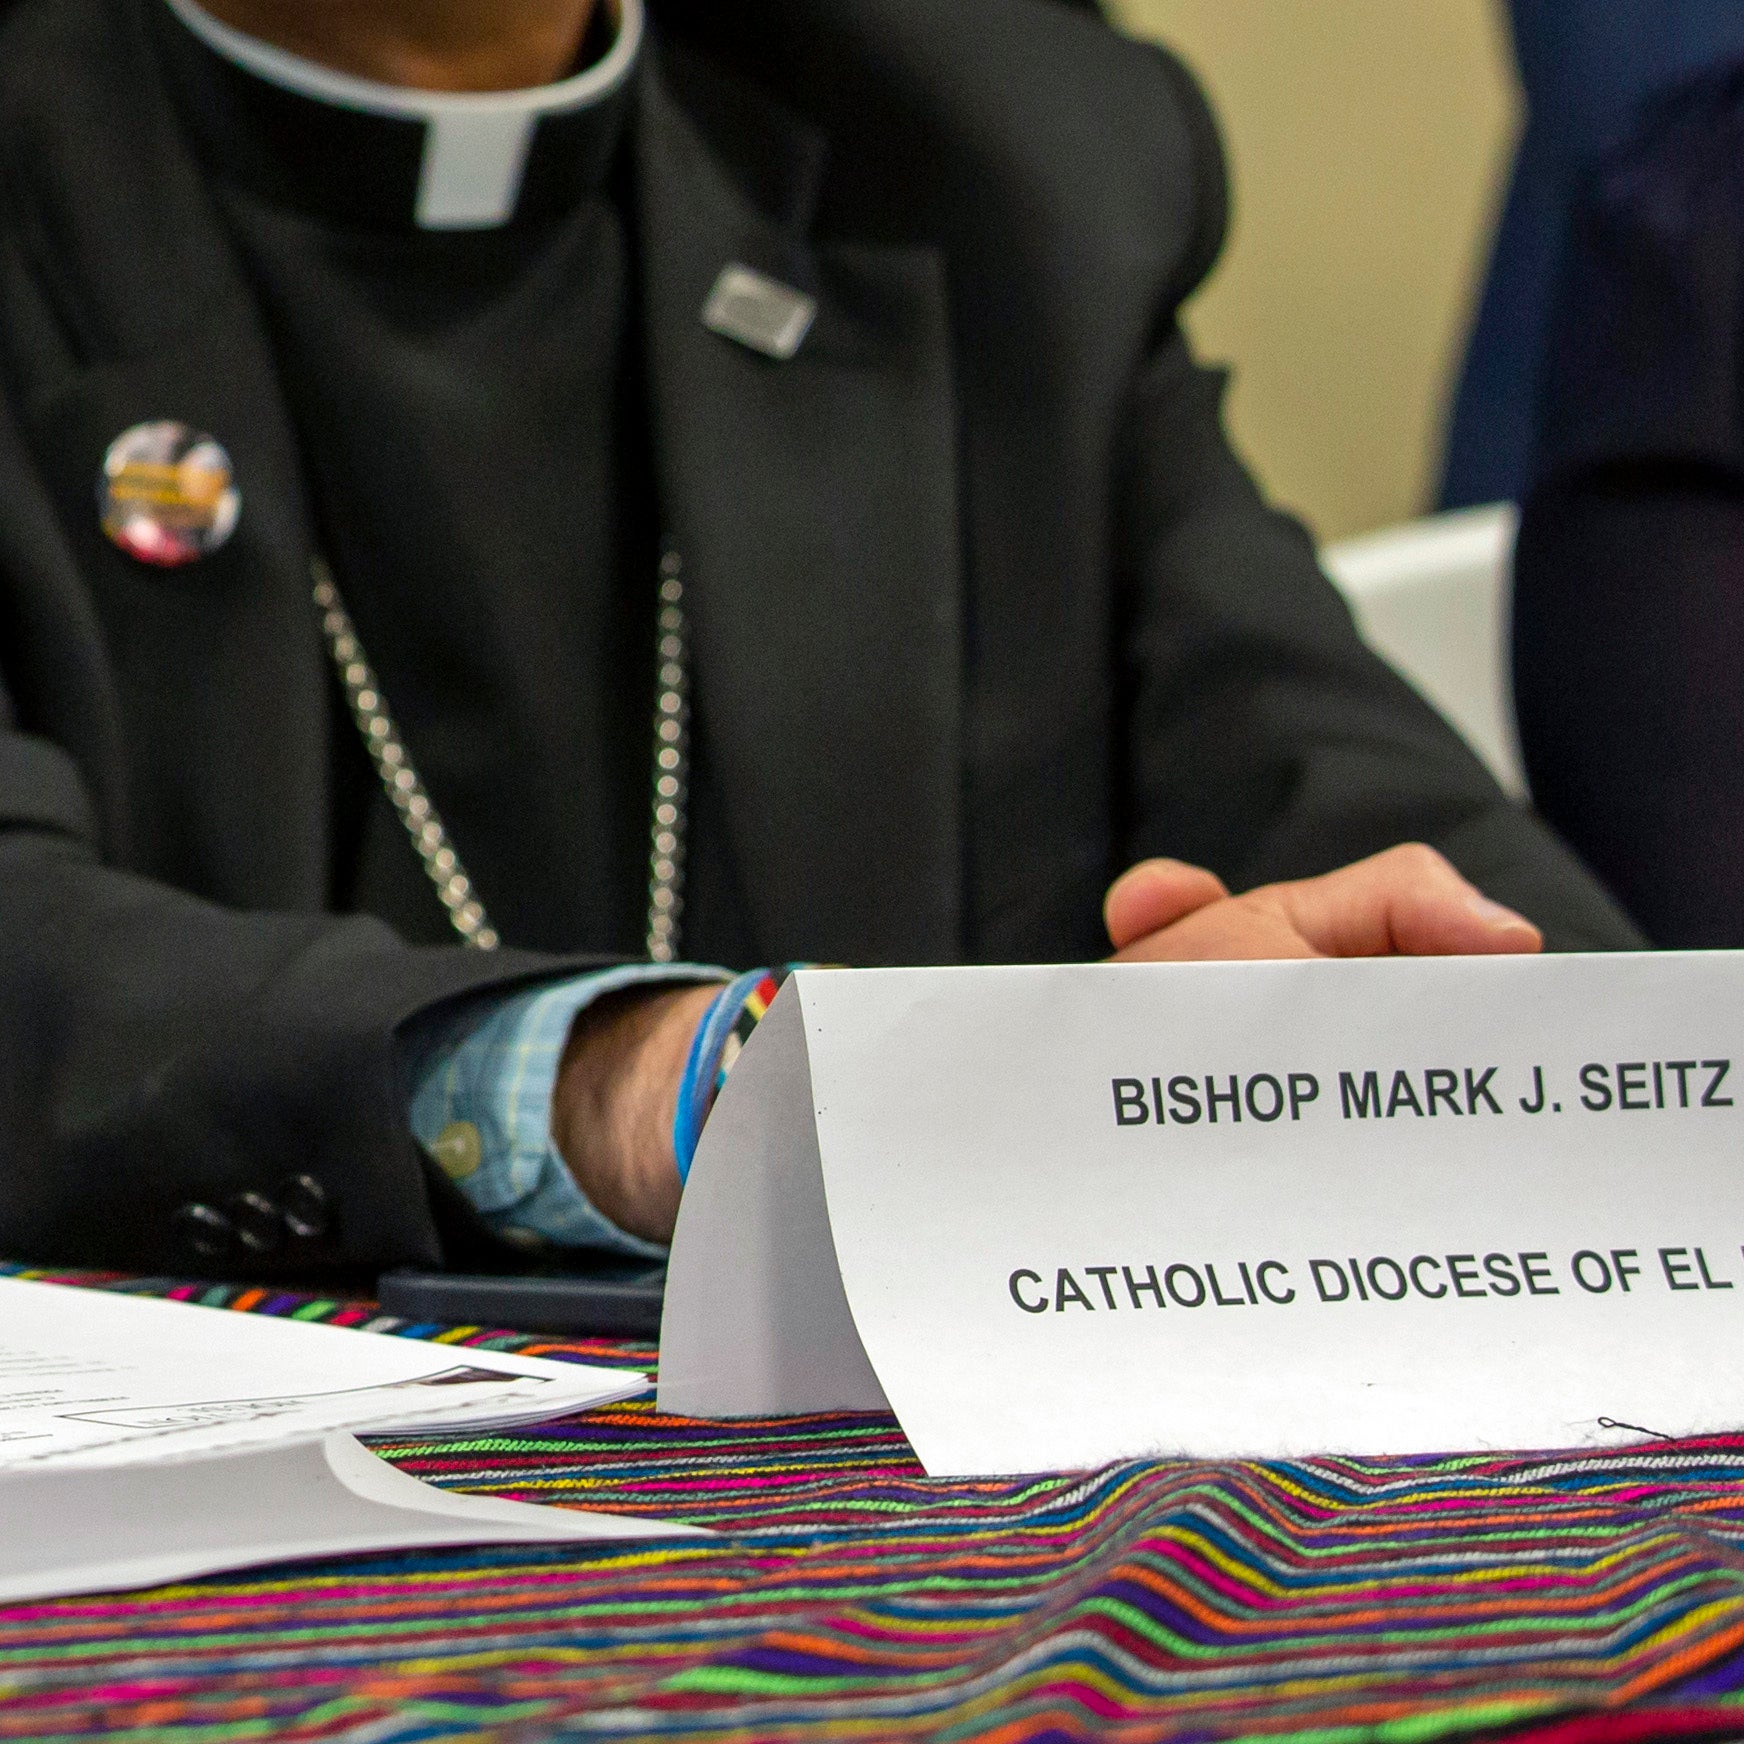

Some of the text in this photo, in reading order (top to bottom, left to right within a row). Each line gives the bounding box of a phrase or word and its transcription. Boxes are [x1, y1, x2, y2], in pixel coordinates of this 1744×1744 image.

[1112, 1060, 1734, 1126] BISHOP MARK J. SEITZ
[1009, 1261, 1295, 1314] CATHOLIC
[1308, 1252, 1560, 1302] DIOCESE
[1571, 1249, 1641, 1294] OF
[1658, 1247, 1734, 1291] EL
